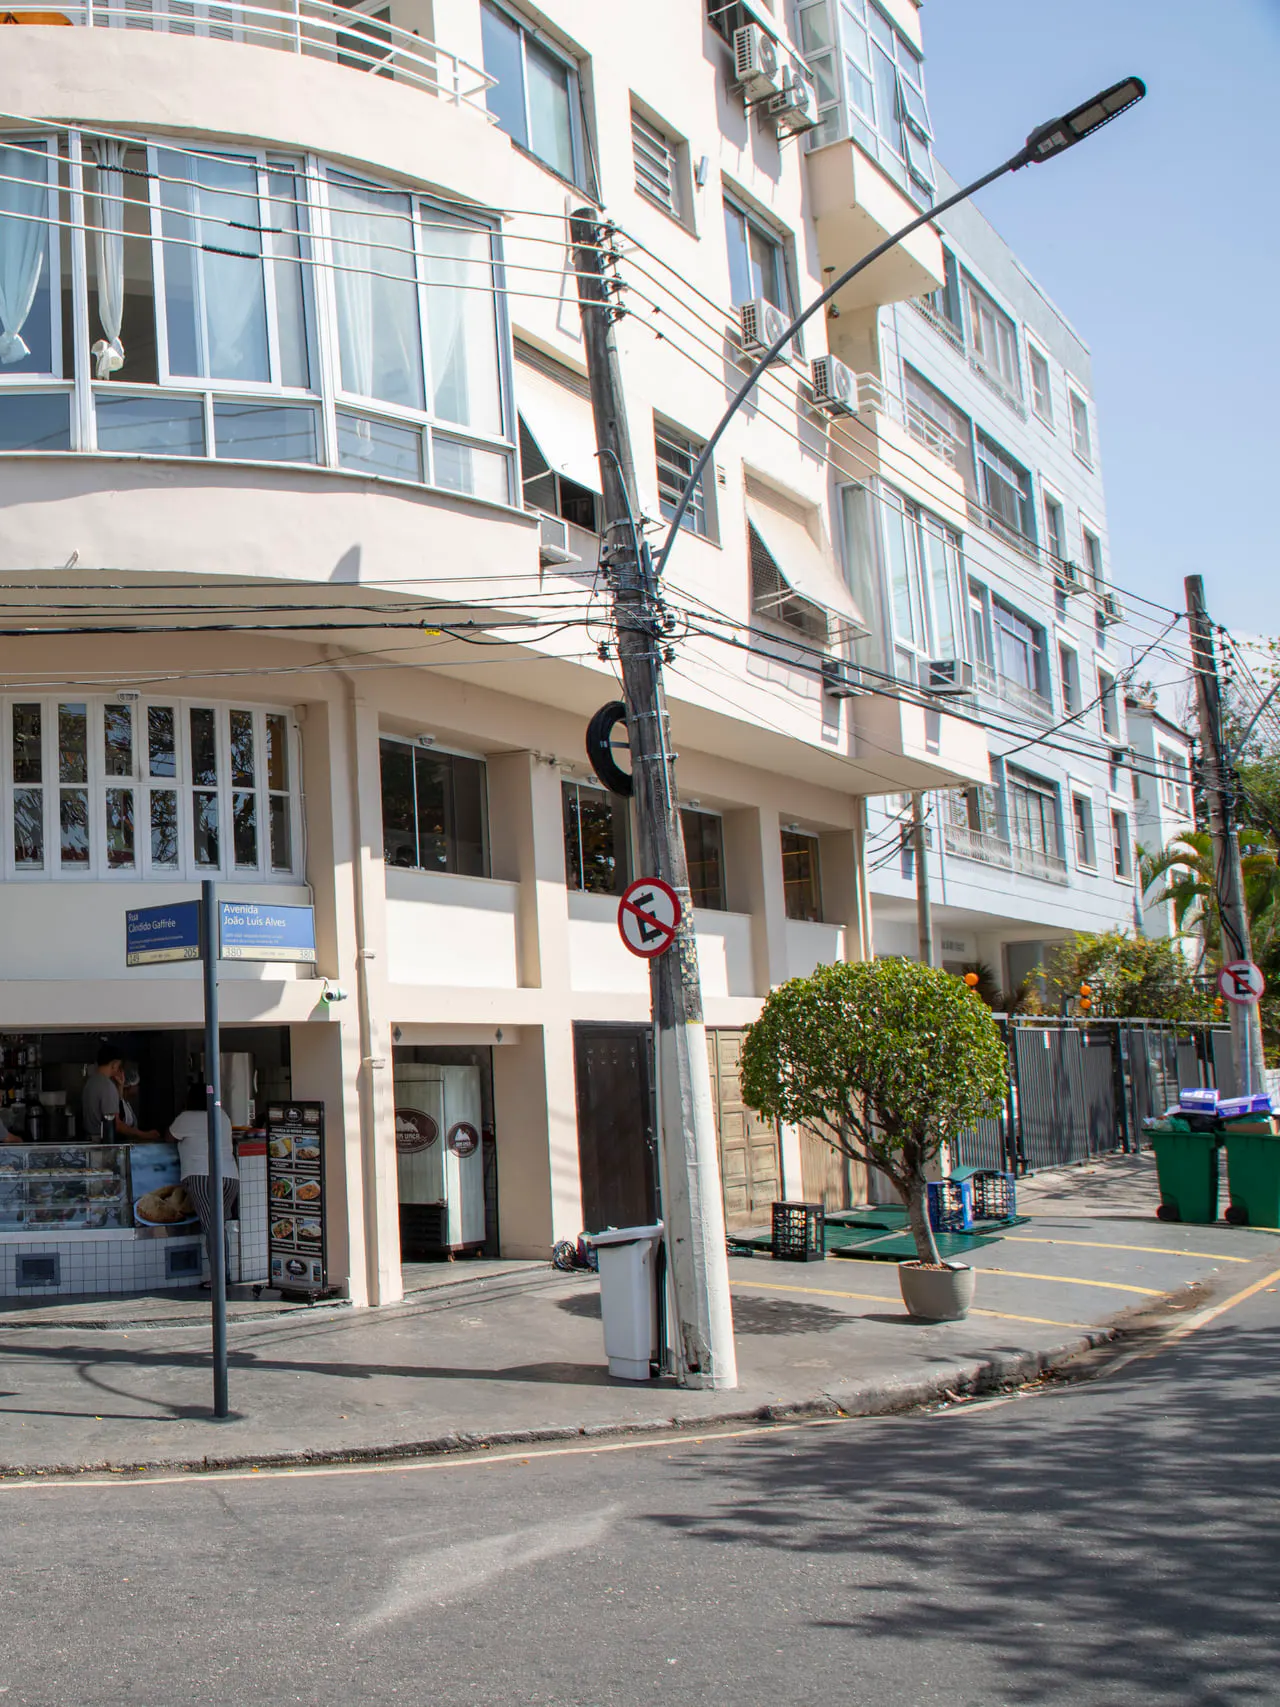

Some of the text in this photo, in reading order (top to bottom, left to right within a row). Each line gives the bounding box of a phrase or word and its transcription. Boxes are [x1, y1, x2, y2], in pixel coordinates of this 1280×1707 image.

[223, 904, 259, 914] Avenida
[128, 913, 139, 922] Rua
[223, 915, 244, 926] João
[265, 917, 286, 927] Alves
[632, 892, 663, 943] E
[183, 947, 197, 958] 205
[224, 946, 314, 960] 380 380
[1233, 970, 1252, 994] E
